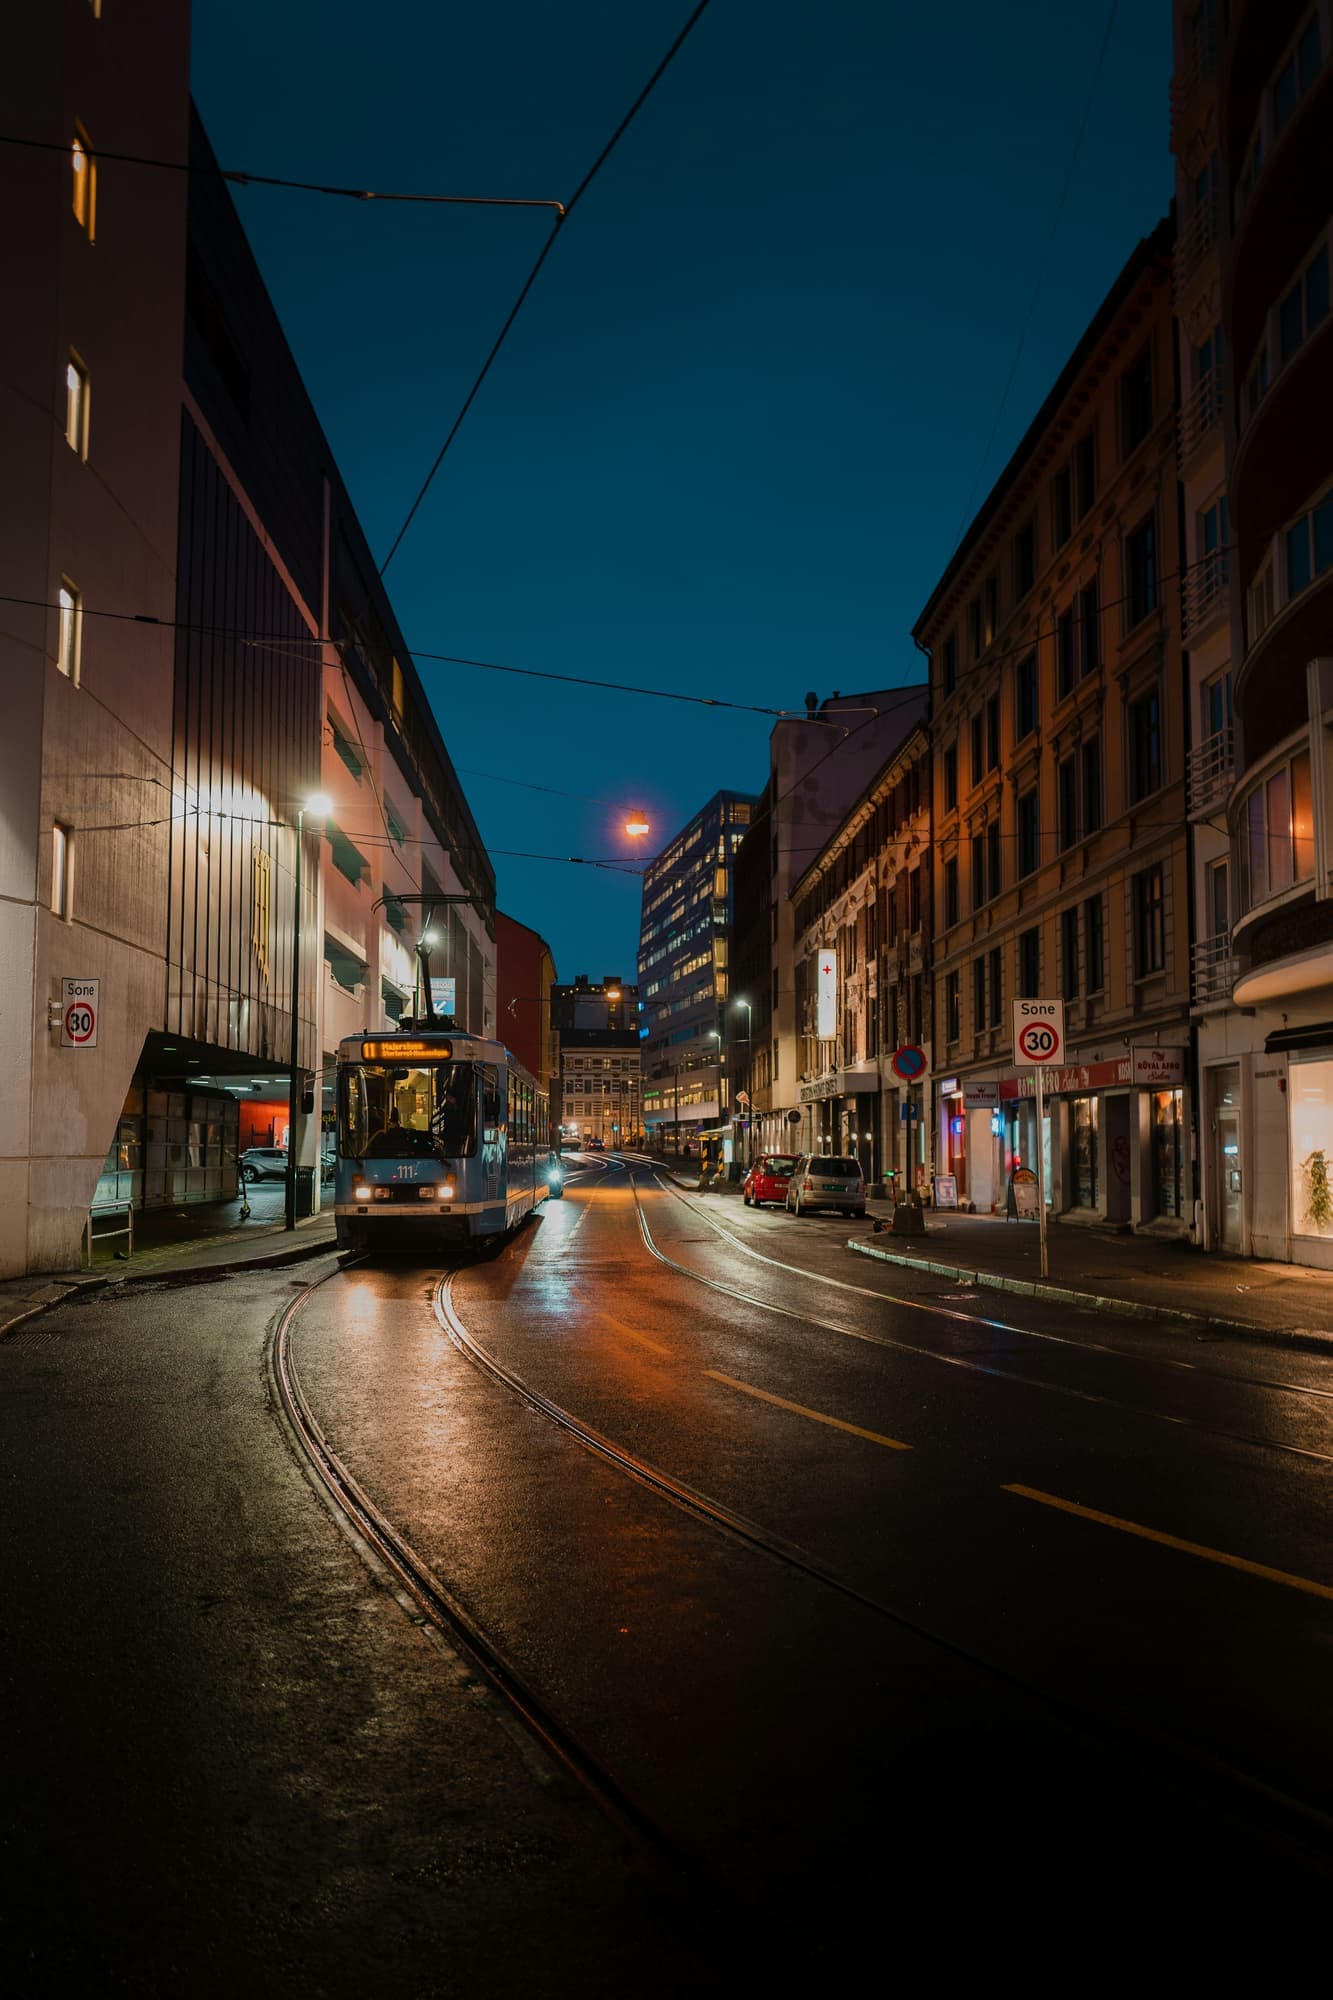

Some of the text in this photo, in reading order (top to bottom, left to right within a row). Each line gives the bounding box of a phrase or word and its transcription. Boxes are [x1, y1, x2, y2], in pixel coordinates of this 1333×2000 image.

[68, 983, 94, 996] Sone
[1021, 1003, 1055, 1015] Sone
[71, 1013, 90, 1032] 30
[1027, 1032, 1052, 1050] 30
[363, 1042, 376, 1058] 11
[1162, 1062, 1180, 1070] AFRO
[397, 1165, 413, 1179] 111
